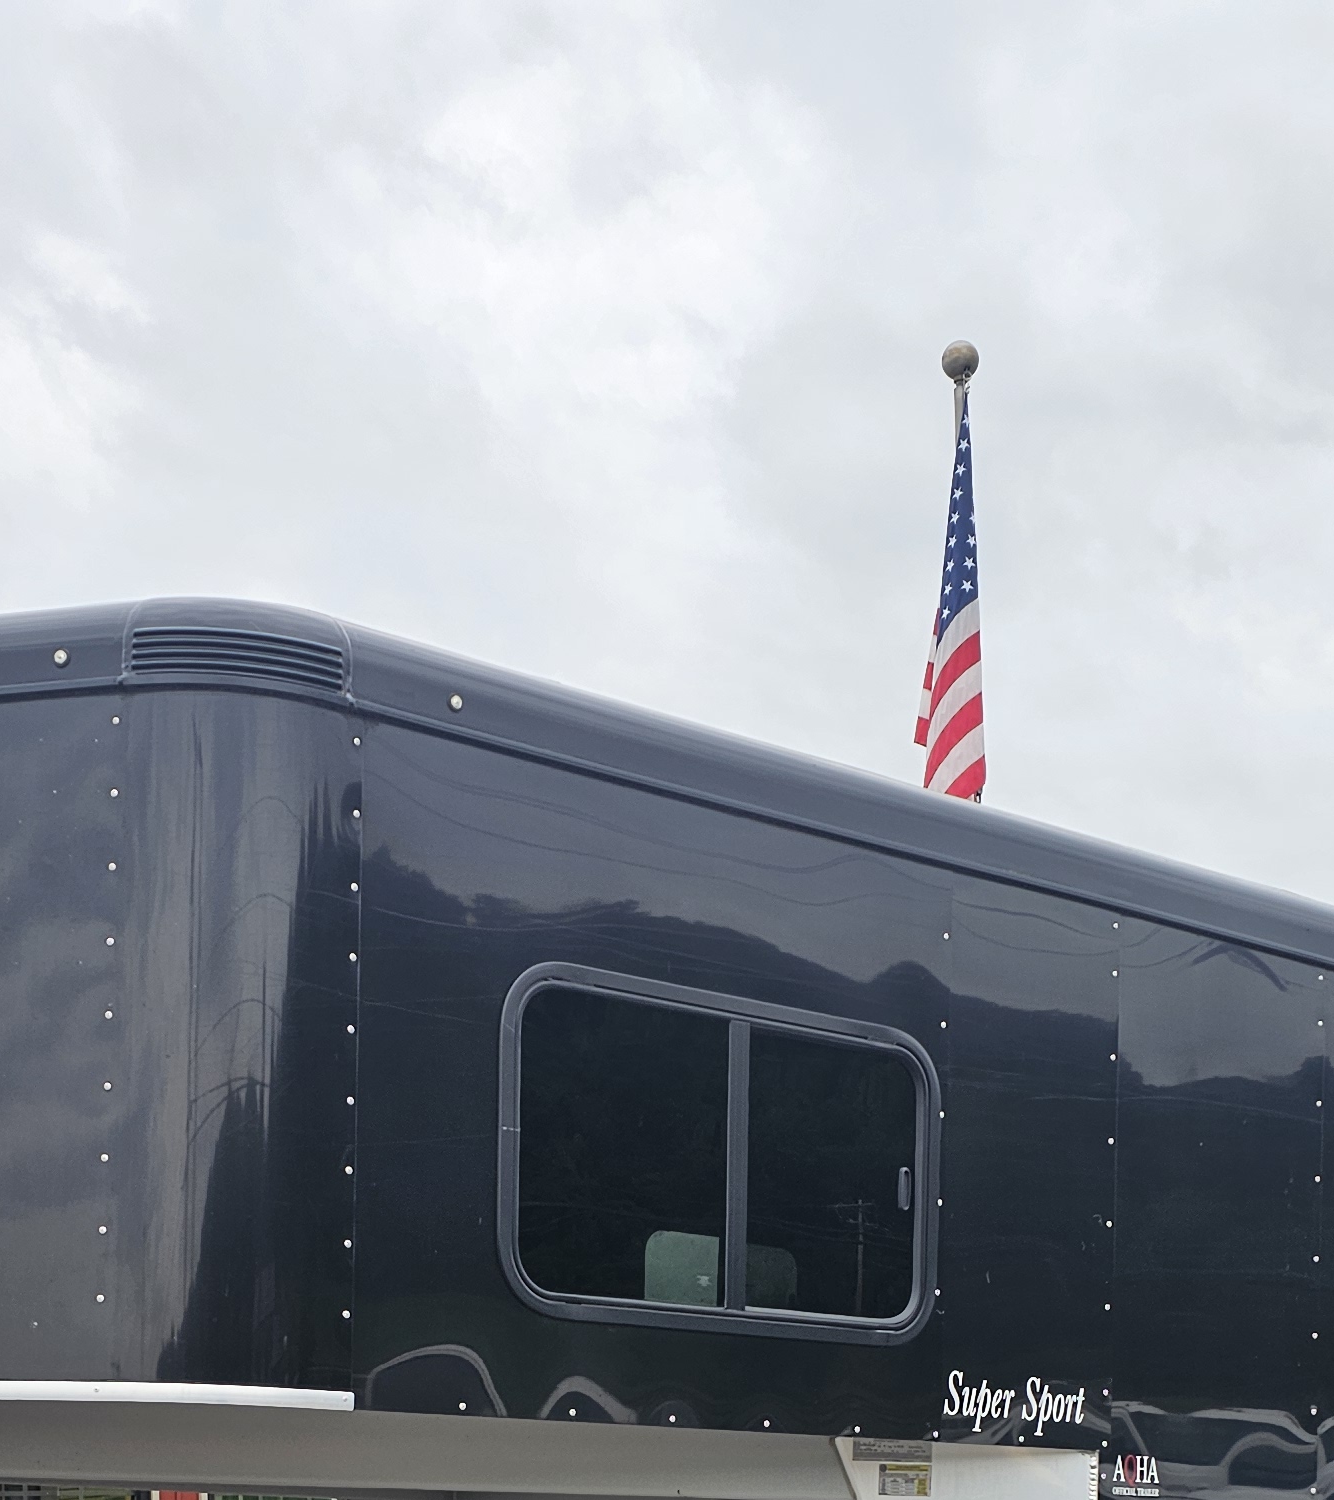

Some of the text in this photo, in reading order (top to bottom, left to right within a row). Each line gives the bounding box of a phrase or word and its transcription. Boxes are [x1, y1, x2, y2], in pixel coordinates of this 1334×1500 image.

[943, 1369, 1086, 1437] Super Sport
[1112, 1454, 1160, 1487] AQHA
